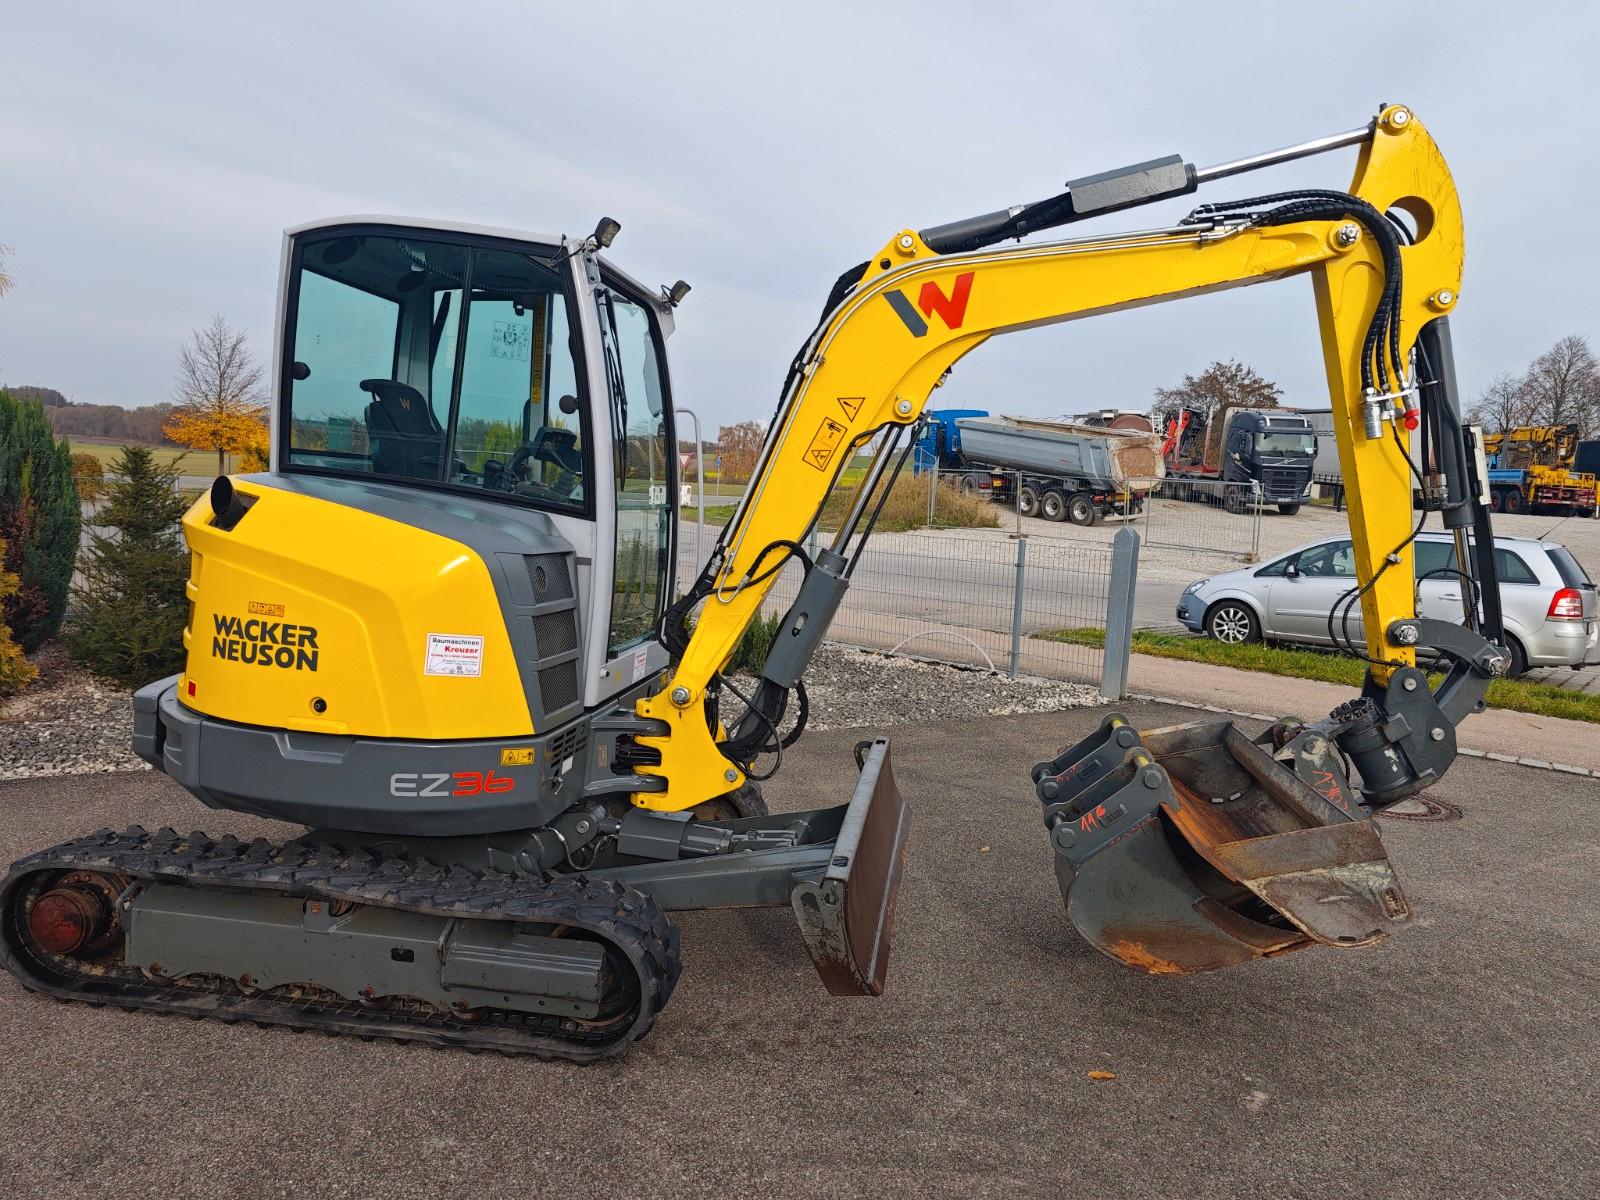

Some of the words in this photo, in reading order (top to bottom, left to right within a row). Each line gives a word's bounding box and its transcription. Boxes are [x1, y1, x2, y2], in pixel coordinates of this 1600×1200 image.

[212, 613, 319, 649] WACKER
[432, 637, 480, 646] Baumaschinen
[211, 636, 319, 672] NEUSON
[444, 645, 479, 654] Kreuzer
[390, 770, 515, 797] EZ36
